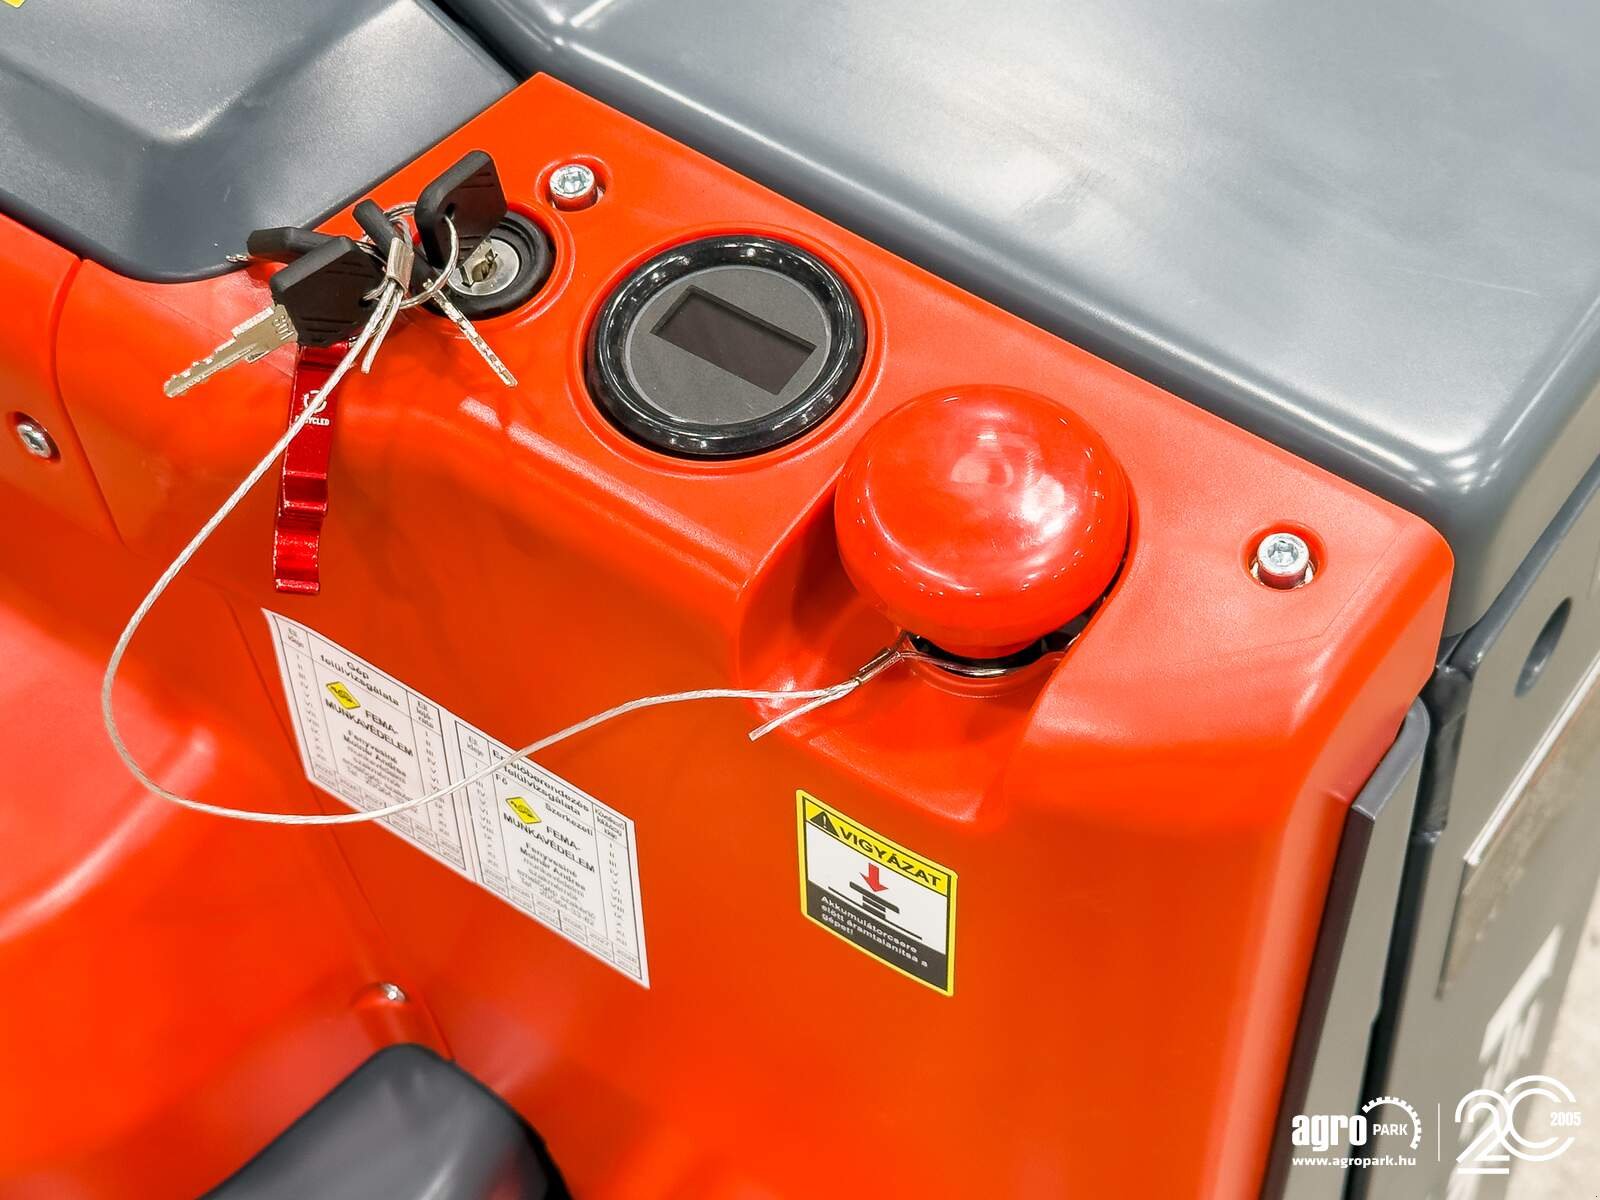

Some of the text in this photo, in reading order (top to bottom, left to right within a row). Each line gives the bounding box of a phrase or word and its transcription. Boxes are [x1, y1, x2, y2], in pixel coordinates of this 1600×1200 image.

[294, 415, 330, 426] YCLED
[319, 653, 400, 708] felülvizsgálata
[346, 660, 370, 681] Gép
[325, 697, 414, 758] MUNKAVÉDELEM
[364, 708, 399, 736] FEMA-
[503, 764, 581, 818] felülvizsgálata
[503, 810, 595, 874] MUNKAVÉDELEM
[545, 802, 593, 838] Szerkezeti
[545, 824, 581, 853] FEMA-
[839, 826, 942, 887] VIGYÁZAT
[821, 905, 845, 925] előtt
[821, 896, 917, 953] Akkumulátorcsere
